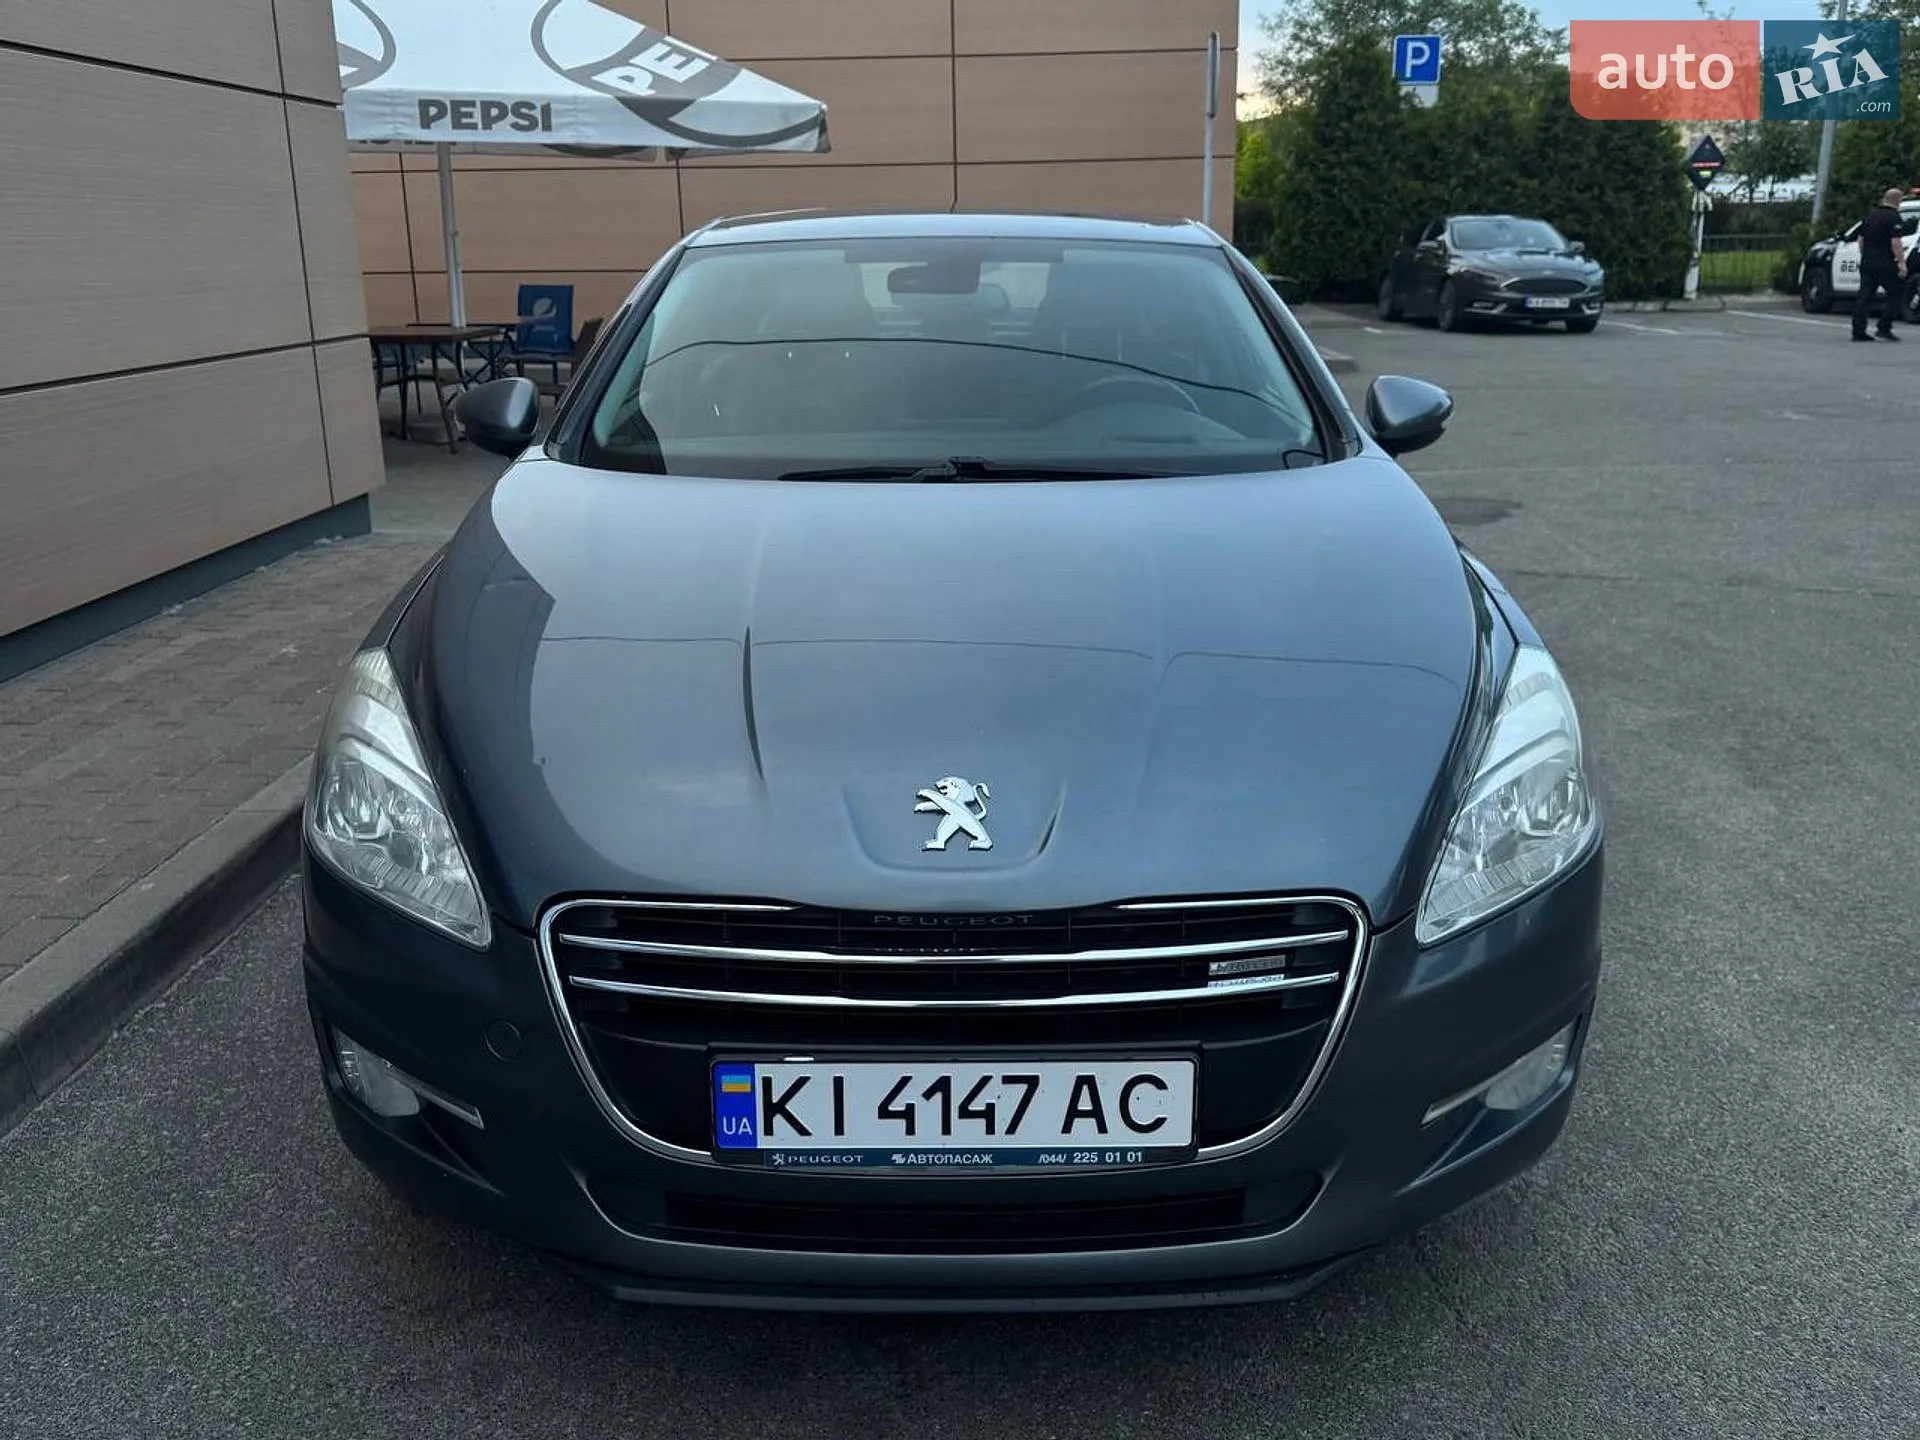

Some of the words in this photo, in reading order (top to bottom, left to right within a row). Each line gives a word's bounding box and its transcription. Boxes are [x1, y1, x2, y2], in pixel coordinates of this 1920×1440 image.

[1405, 41, 1430, 78] P
[417, 98, 552, 132] PEPSI
[873, 915, 1034, 926] PEUGEOT
[761, 1075, 845, 1137] KI
[877, 1075, 1041, 1136] 4147
[1061, 1073, 1169, 1135] AC
[722, 1116, 753, 1136] UA
[787, 1153, 864, 1164] PEUGEOT
[907, 1153, 993, 1165] АВТОПАСАЖ
[1072, 1152, 1098, 1164] 225
[1105, 1151, 1121, 1163] 01
[1127, 1151, 1143, 1163] 01
